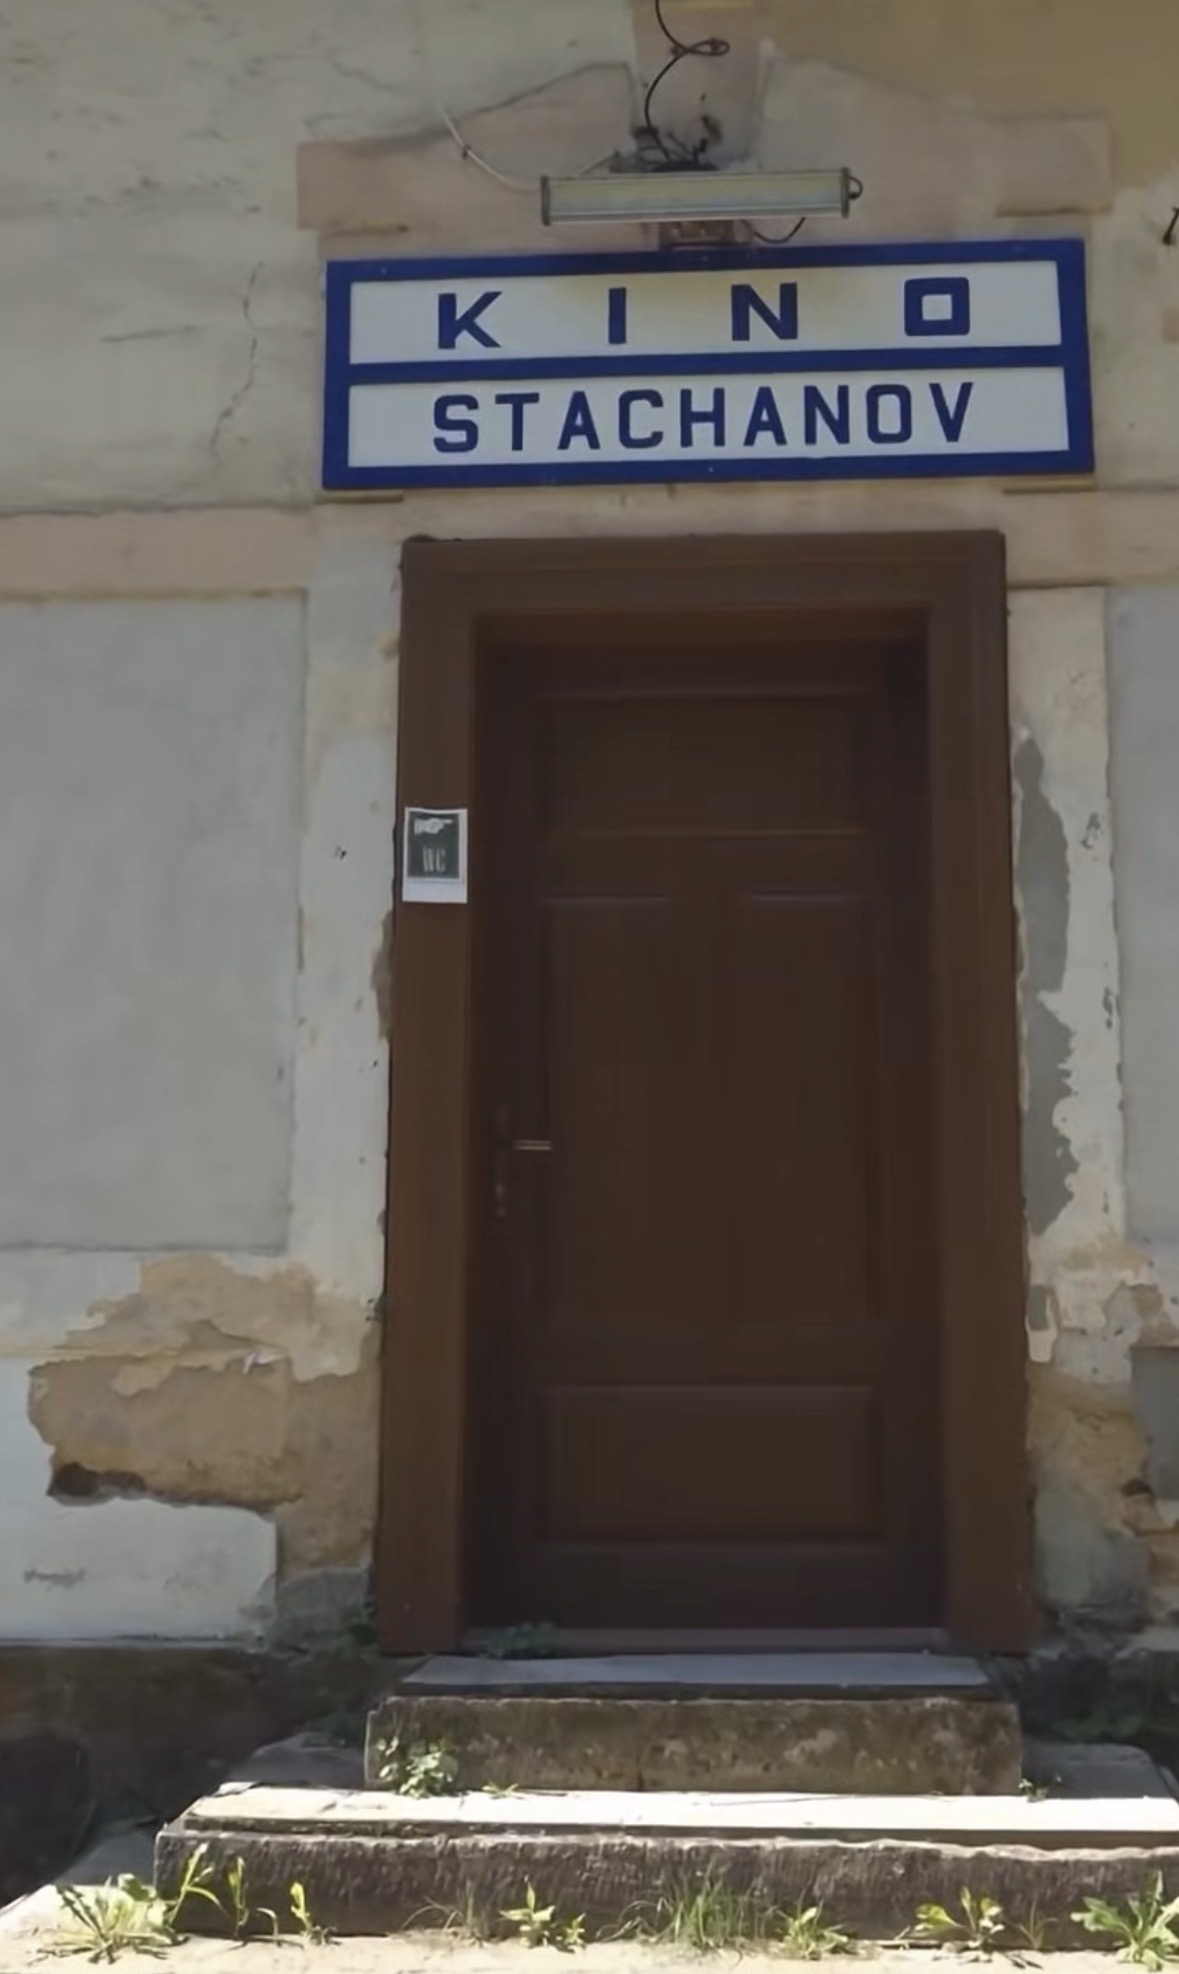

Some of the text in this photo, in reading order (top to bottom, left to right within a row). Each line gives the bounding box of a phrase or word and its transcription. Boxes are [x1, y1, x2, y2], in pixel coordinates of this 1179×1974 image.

[437, 276, 971, 350] KINO
[432, 381, 974, 453] STACHANOV
[422, 847, 447, 872] WC
